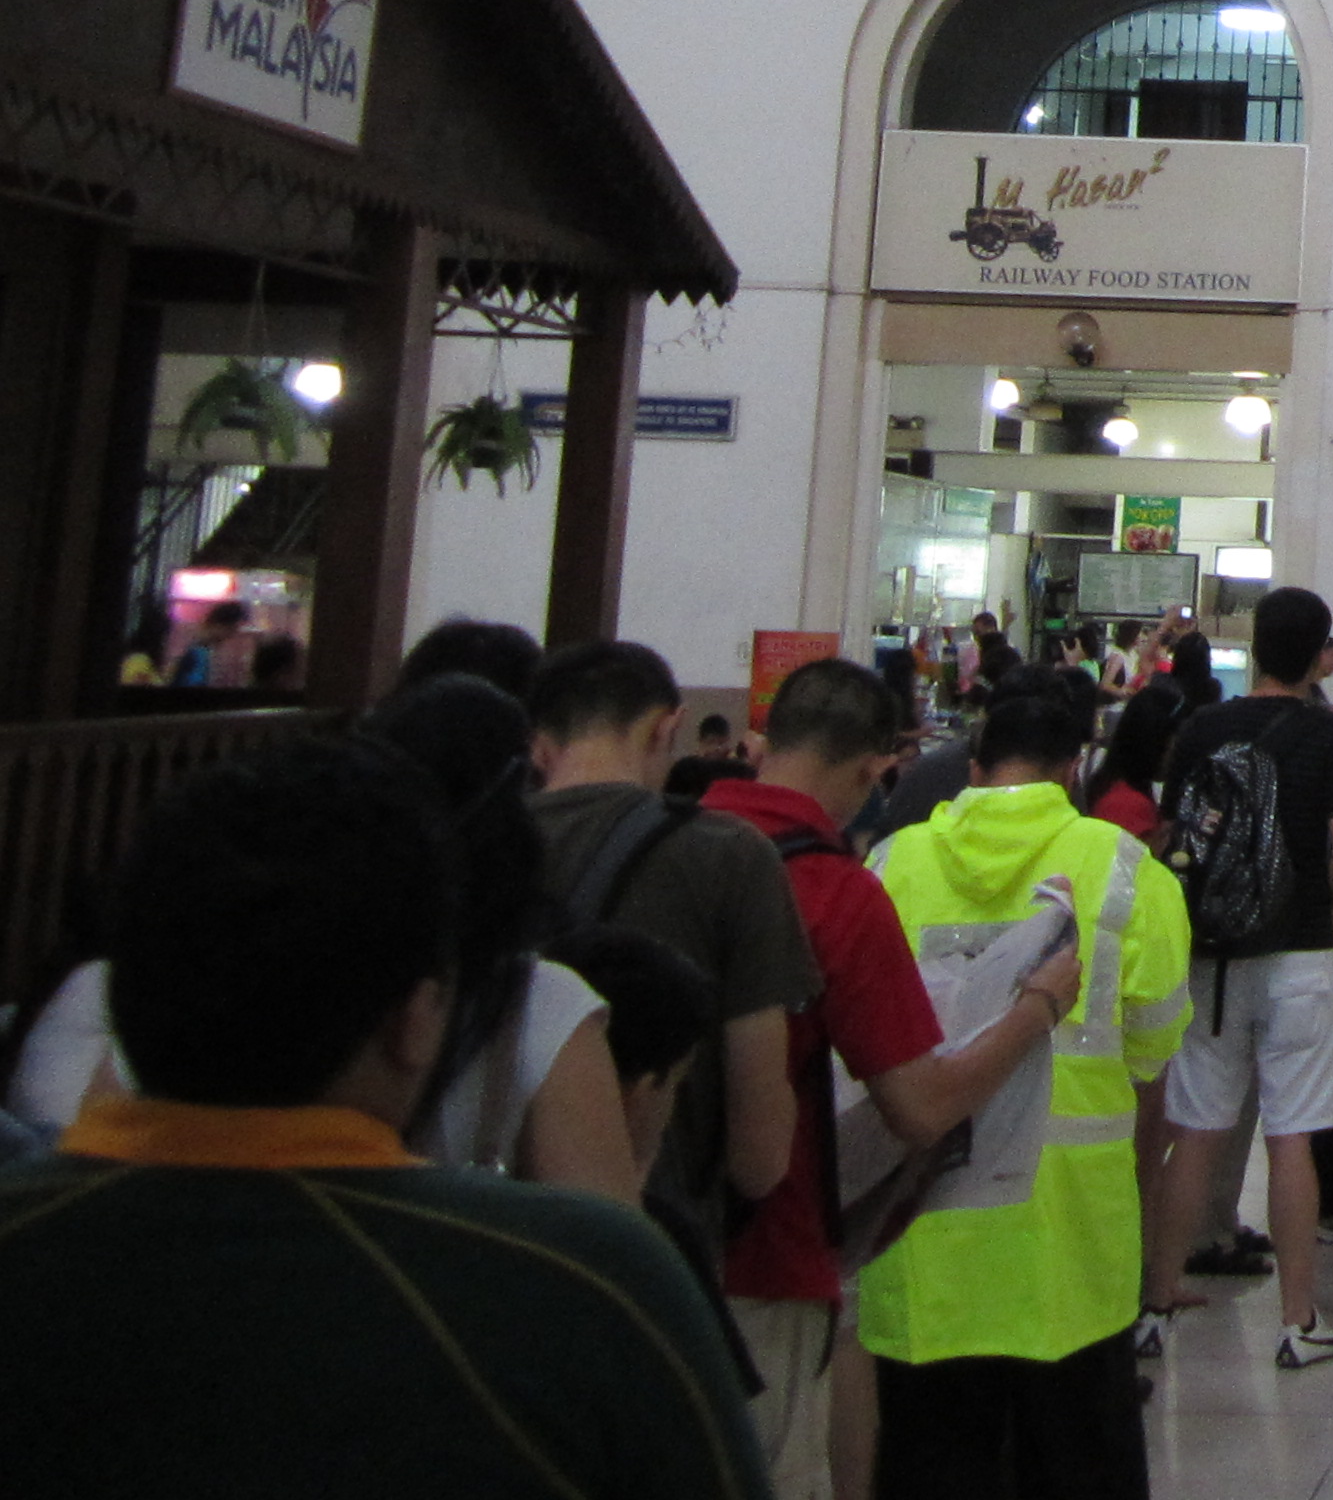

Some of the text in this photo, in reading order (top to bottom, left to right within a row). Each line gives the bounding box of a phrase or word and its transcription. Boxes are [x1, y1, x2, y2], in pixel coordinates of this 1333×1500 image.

[980, 266, 1252, 292] RAILWAY FOOD STATION
